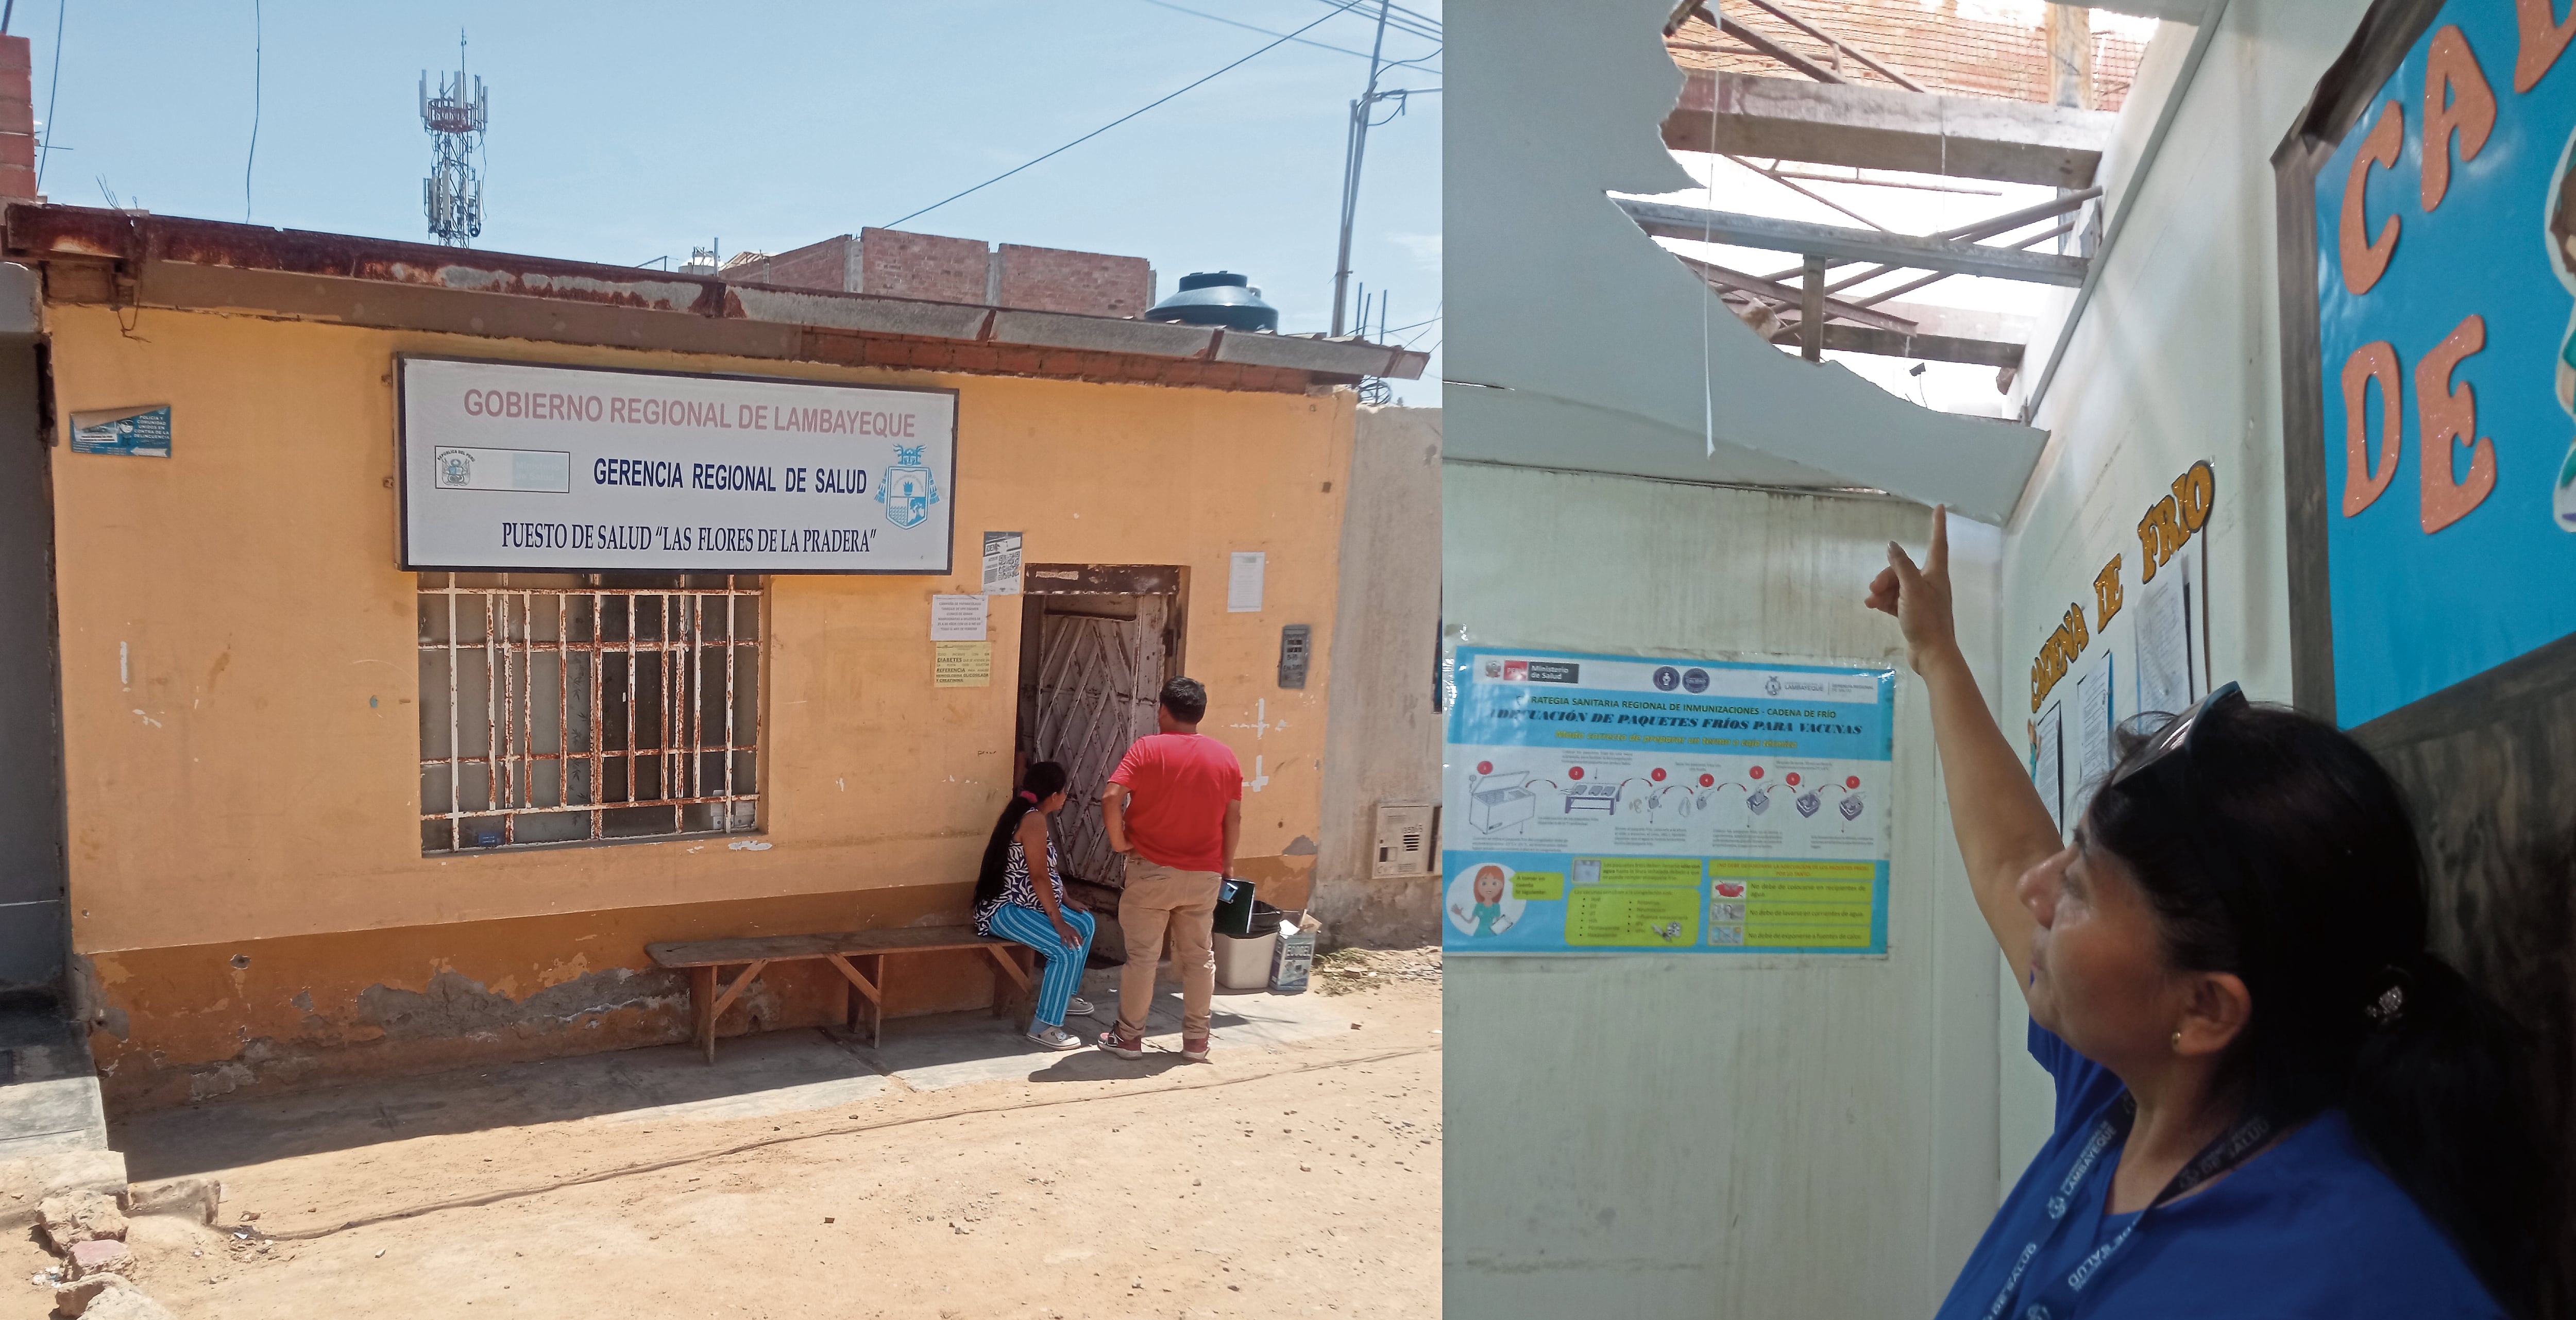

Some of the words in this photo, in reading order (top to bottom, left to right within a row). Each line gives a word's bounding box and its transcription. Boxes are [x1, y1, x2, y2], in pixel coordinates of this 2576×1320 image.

[464, 388, 603, 422] GOBIERNO
[610, 397, 732, 428] REGIONAL
[738, 404, 768, 430] DE
[773, 405, 916, 438] LAMBAYEQUE
[2341, 314, 2497, 535] DE
[594, 458, 684, 488] GERENCIA
[692, 463, 776, 492] REGIONAL
[785, 467, 807, 493] DE
[815, 468, 867, 495] SALUD
[502, 522, 567, 549] PUESTO
[571, 524, 594, 549] DE
[598, 524, 652, 550] SALUD
[697, 527, 753, 552] FLORES
[757, 528, 778, 553] DE
[781, 529, 800, 553] LA
[1572, 698, 1619, 708] SANITARIA
[1622, 701, 1667, 710] REGIONAL
[1683, 704, 1759, 715] INMUNIZACIONES
[1767, 708, 1802, 717] CADENA
[1817, 709, 1837, 718] FRÍO
[1591, 713, 1614, 723] DE
[1617, 714, 1699, 727] PAQUETES
[1702, 717, 1749, 730] FRÍOS
[1753, 720, 1793, 732] PARA
[1800, 722, 1862, 734] VACUNAS
[1629, 733, 1640, 742] de
[2062, 1125, 2117, 1196] LAMBAYEQUE
